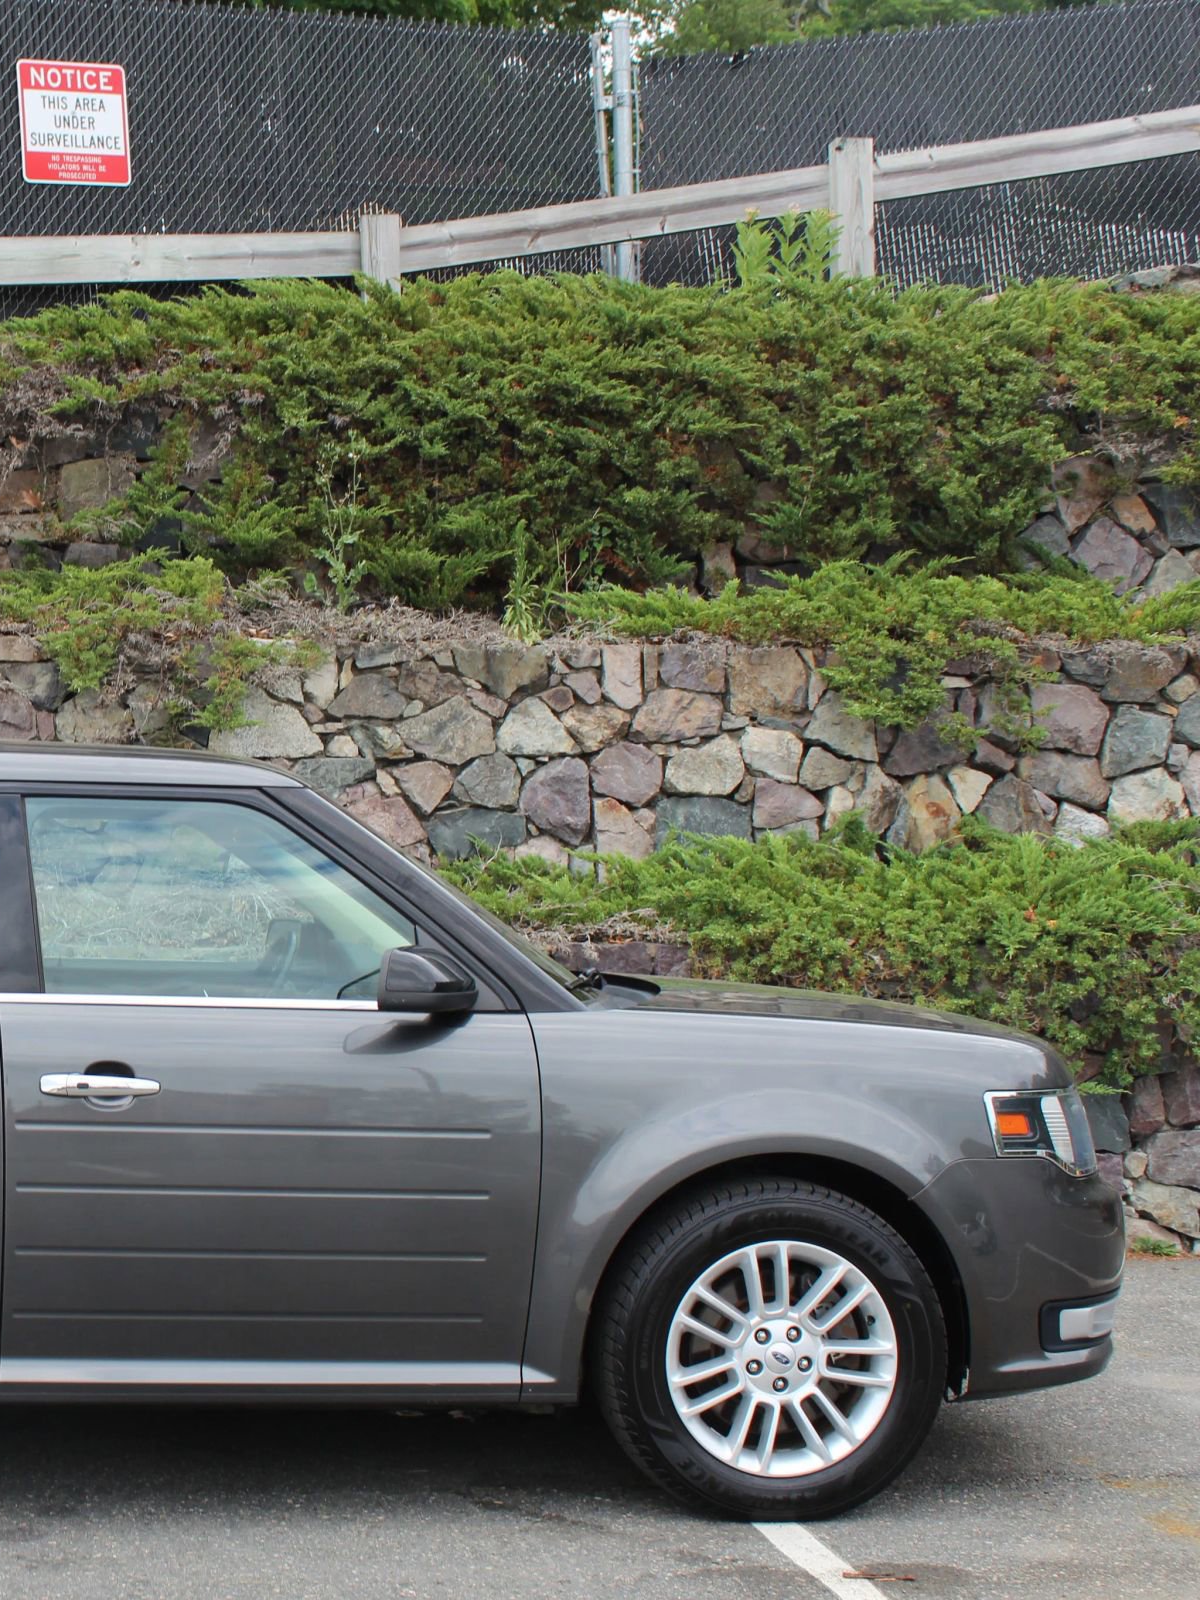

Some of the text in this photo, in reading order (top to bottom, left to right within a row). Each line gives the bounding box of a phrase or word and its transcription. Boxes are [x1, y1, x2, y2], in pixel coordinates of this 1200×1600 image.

[30, 66, 113, 91] NOTICE
[41, 95, 106, 112] THIS AREA
[54, 114, 96, 130] UNDER
[30, 132, 121, 151] SURVEILLANCE
[48, 162, 106, 172] VIOLATORS WILL BE
[51, 154, 102, 164] NO TRESPASSING
[58, 171, 97, 180] PROSECUTED
